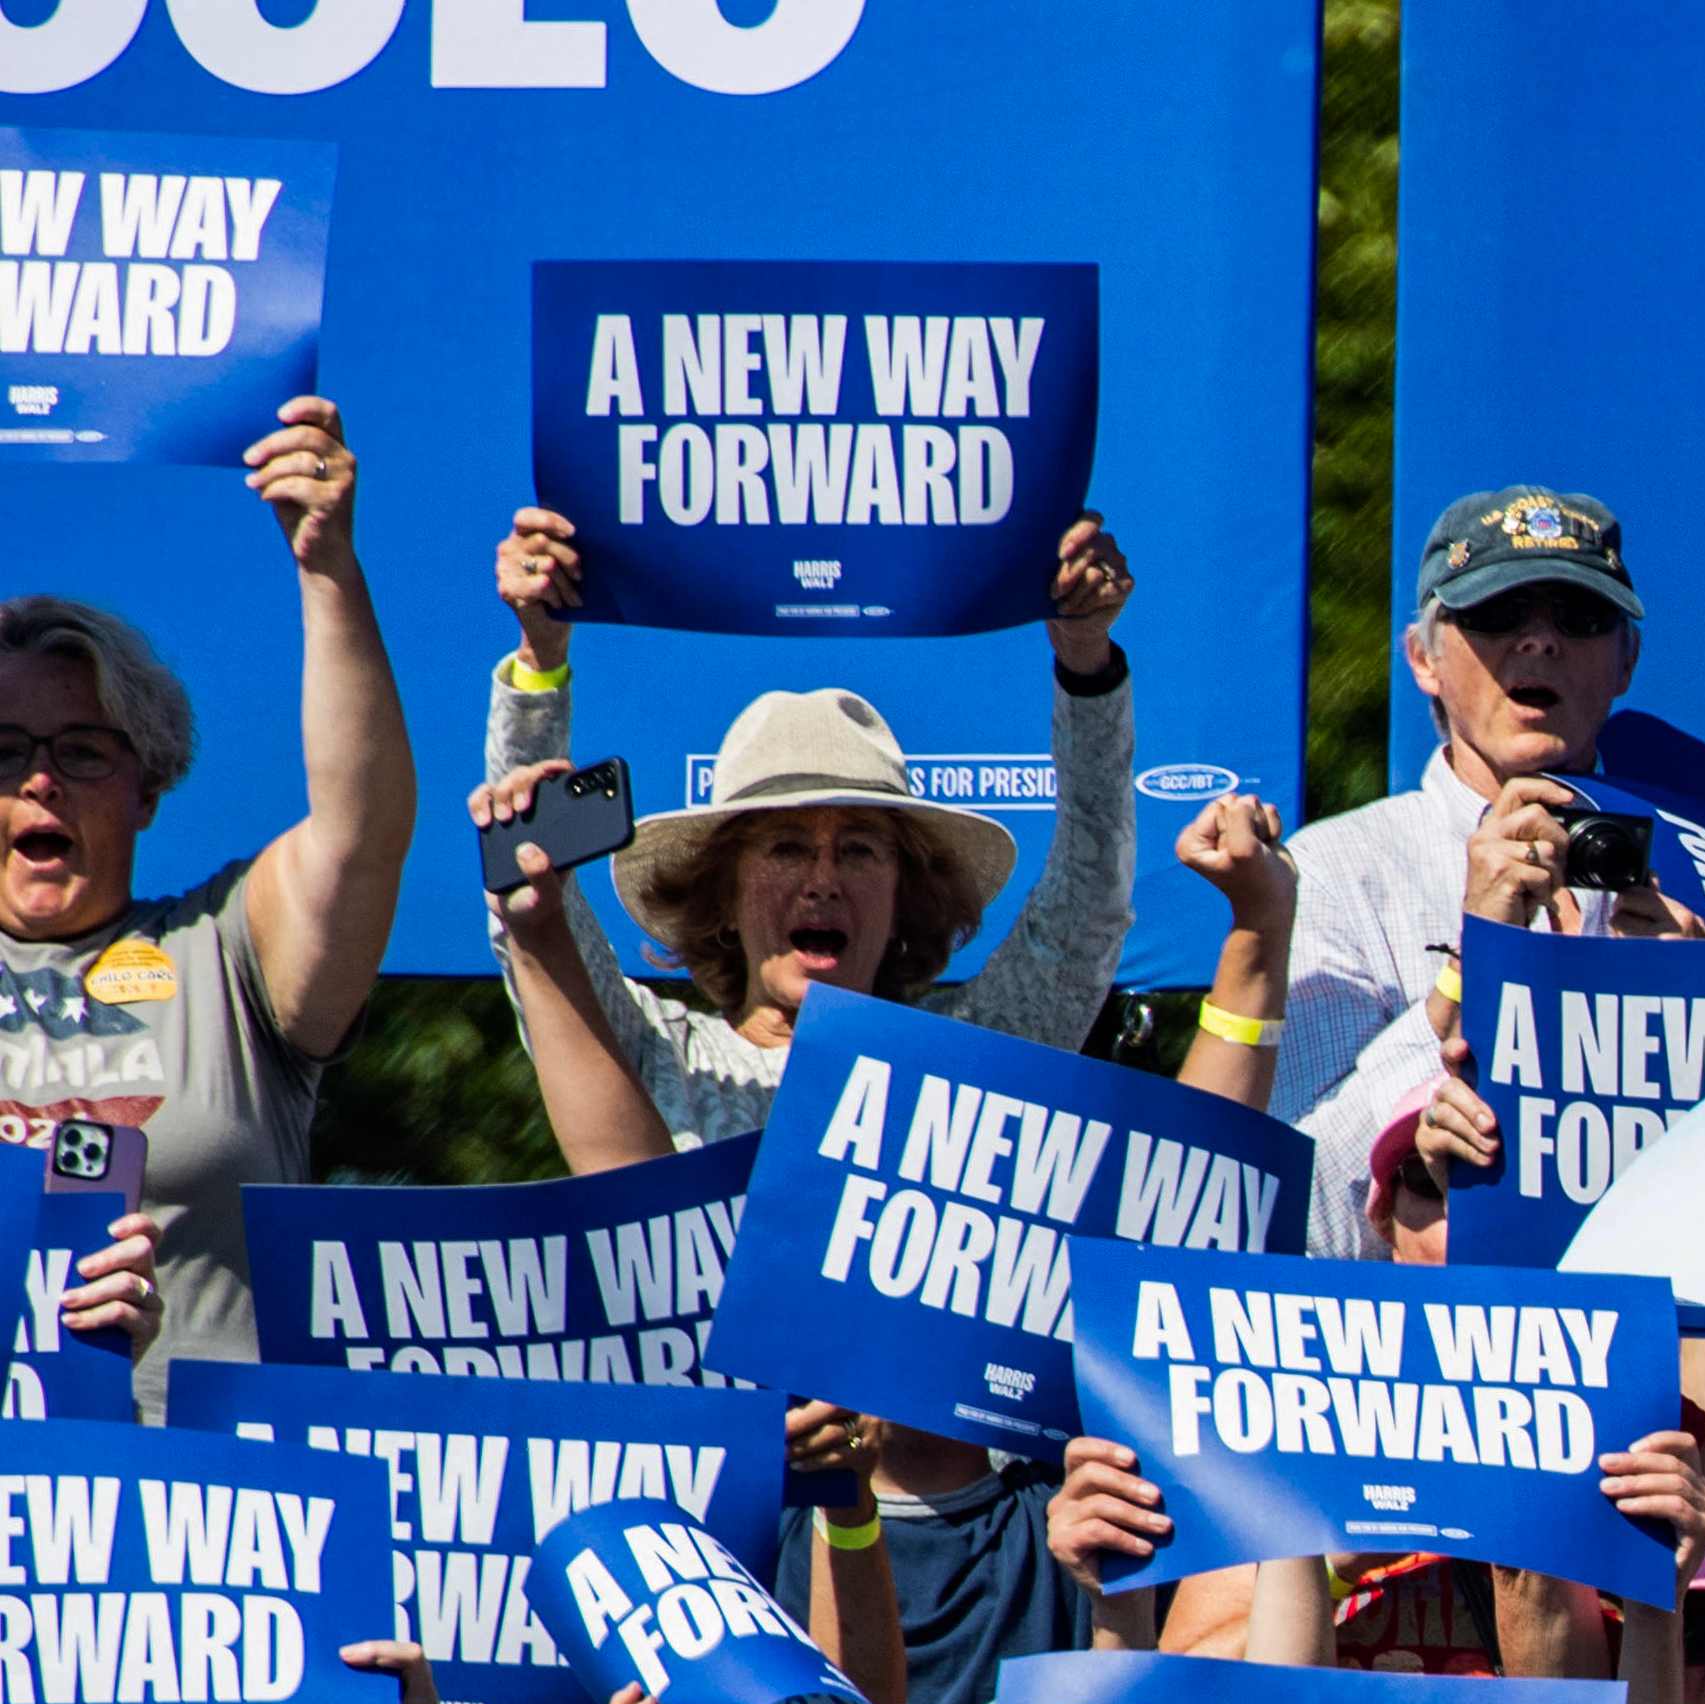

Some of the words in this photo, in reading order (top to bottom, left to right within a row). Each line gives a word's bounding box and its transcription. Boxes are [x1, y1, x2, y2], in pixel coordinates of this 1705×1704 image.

[100, 174, 282, 261] WAY
[0, 261, 236, 357] WARD
[9, 386, 58, 406] HARRIS
[586, 314, 643, 416] A
[663, 314, 847, 416] NEW
[864, 316, 1045, 418] WAY
[618, 423, 1014, 526] FORWARD
[793, 560, 842, 580] HARRIS
[930, 767, 974, 797] FOR
[978, 767, 1058, 798] PRESID
[1491, 981, 1542, 1087] A
[818, 1055, 891, 1171] A
[899, 1074, 1112, 1225] NEW
[1116, 1130, 1279, 1253] WAY
[311, 1240, 368, 1339] A
[378, 1235, 567, 1339] NEW
[821, 1173, 1073, 1343] FORW
[984, 1362, 1036, 1392] HARRIS
[1132, 1281, 1193, 1360] A
[1208, 1287, 1405, 1377] NEW
[1423, 1304, 1618, 1388] WAY
[989, 1382, 1025, 1401] WALZ
[1168, 1365, 1594, 1475] FORWARD
[139, 1479, 335, 1594] WAY
[1362, 1484, 1417, 1503] HARRIS
[564, 1547, 632, 1649] A
[623, 1522, 765, 1595] NE
